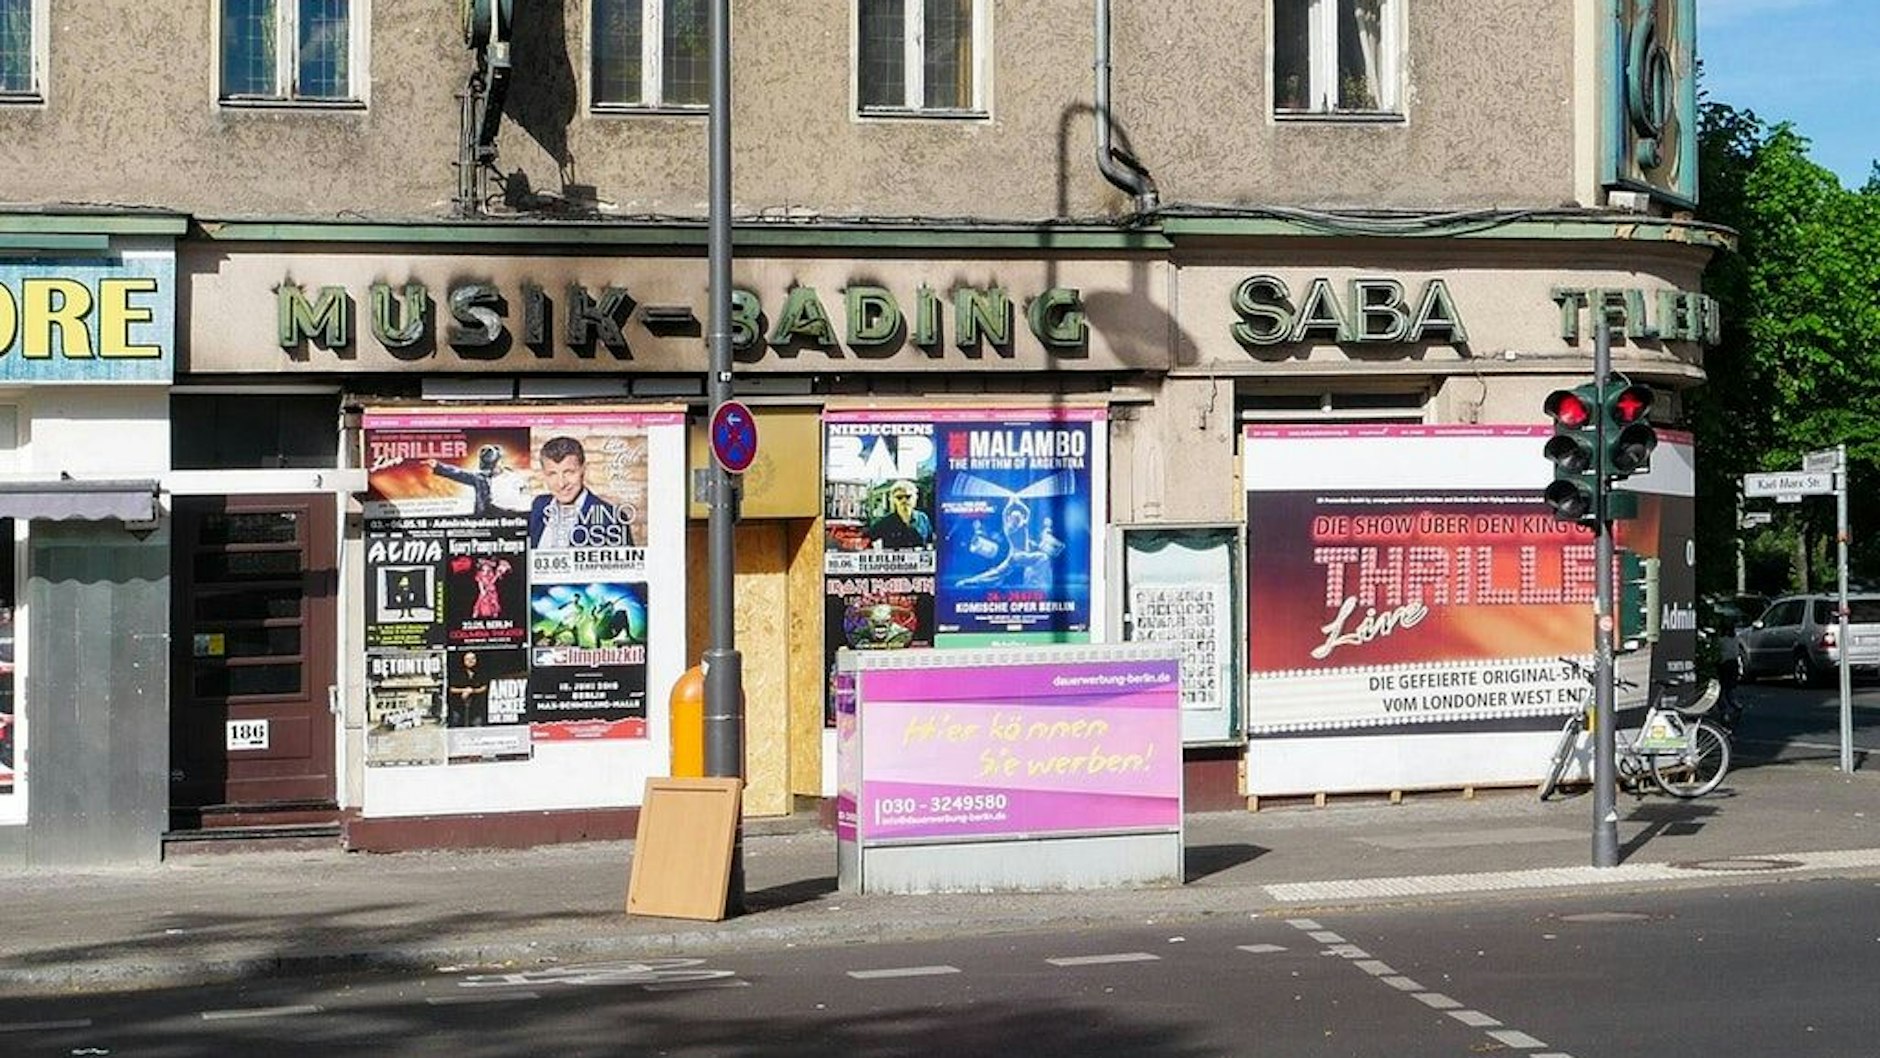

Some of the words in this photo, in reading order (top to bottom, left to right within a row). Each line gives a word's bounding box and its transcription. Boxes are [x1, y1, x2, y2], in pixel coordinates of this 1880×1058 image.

[0, 277, 161, 359] RE
[1231, 275, 1468, 346] SABA
[829, 424, 933, 435] NIEDECKENS
[370, 441, 467, 459] THRILLER
[969, 431, 1086, 457] MALAMBO
[827, 435, 934, 480] BAP
[949, 458, 968, 469] THE
[971, 458, 1013, 469] RHYTHM
[1029, 457, 1085, 469] ARGENTINA
[1316, 517, 1347, 535] DIE
[1356, 517, 1413, 535] SHOW
[1420, 512, 1469, 534] ÜBER
[1477, 517, 1515, 534] DEN
[1523, 517, 1568, 534] KING
[368, 540, 443, 563] ALMA
[574, 549, 645, 562] BERLIN
[859, 554, 905, 563] BERLIN
[1314, 545, 1619, 607] THRILLE
[955, 602, 1008, 613] KOMISCHE
[1010, 602, 1036, 612] OPER
[1038, 601, 1075, 612] BERLIN
[489, 678, 528, 699] ANDY
[1053, 672, 1171, 687] dauerwerbung-berlin.de
[1369, 676, 1395, 692] DIE
[1399, 671, 1477, 689] GEFEIERTE
[1383, 697, 1418, 713] VOM
[1422, 692, 1508, 711] LONDONER
[1511, 688, 1551, 706] WEST
[231, 724, 264, 739] 186
[980, 748, 1022, 778] Sie
[1027, 742, 1155, 775] werben!
[881, 798, 916, 814] 030
[930, 794, 1007, 812] 3249580
